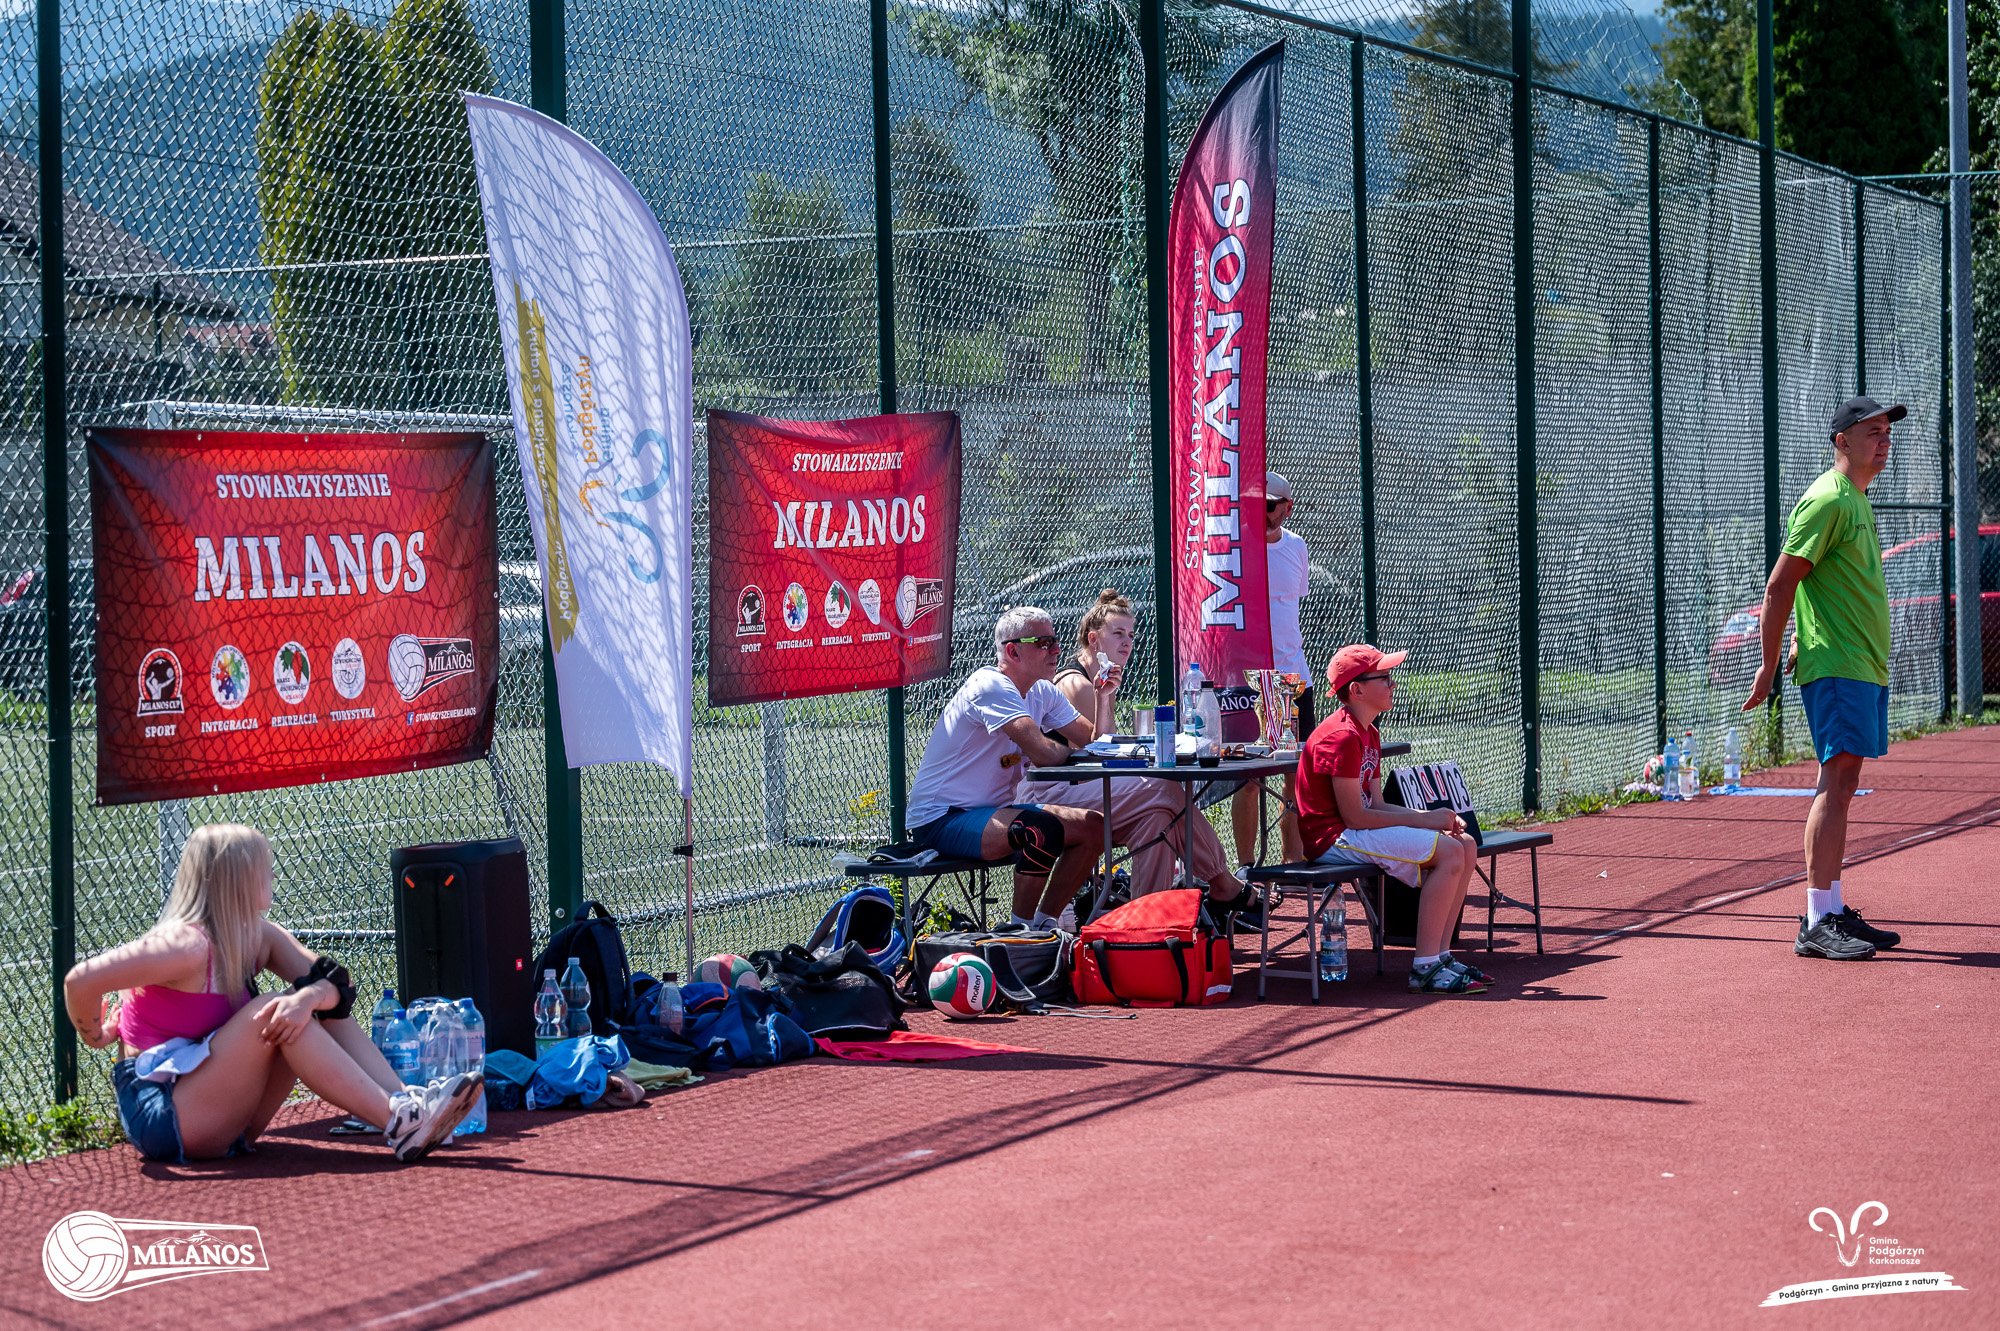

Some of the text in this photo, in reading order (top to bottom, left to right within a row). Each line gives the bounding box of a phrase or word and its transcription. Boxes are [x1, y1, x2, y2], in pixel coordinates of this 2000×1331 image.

[1185, 248, 1204, 570] STOWARZYSZENIE
[1200, 178, 1251, 632] MILANOS
[792, 451, 904, 472] STOWARZYSZENIE
[217, 473, 392, 499] STOWARZYSZENIE
[772, 494, 927, 549] MILANOS
[193, 531, 428, 602] MILANOS
[918, 591, 943, 606] MILANOS
[741, 643, 761, 653] SPORT
[776, 639, 814, 650] INTEGRACJA
[821, 635, 853, 646] REKREACJA
[428, 653, 472, 673] MILANOS
[141, 700, 181, 711] MILANOS CUP
[1220, 695, 1257, 711] ANOS
[271, 713, 318, 727] REKREACJA
[330, 707, 376, 722] TURYSTYKA
[145, 724, 177, 738] SPORT
[201, 718, 259, 733] INTEGRACJA
[1434, 770, 1446, 797] 0
[1445, 767, 1471, 810] 03
[970, 974, 982, 1004] molten
